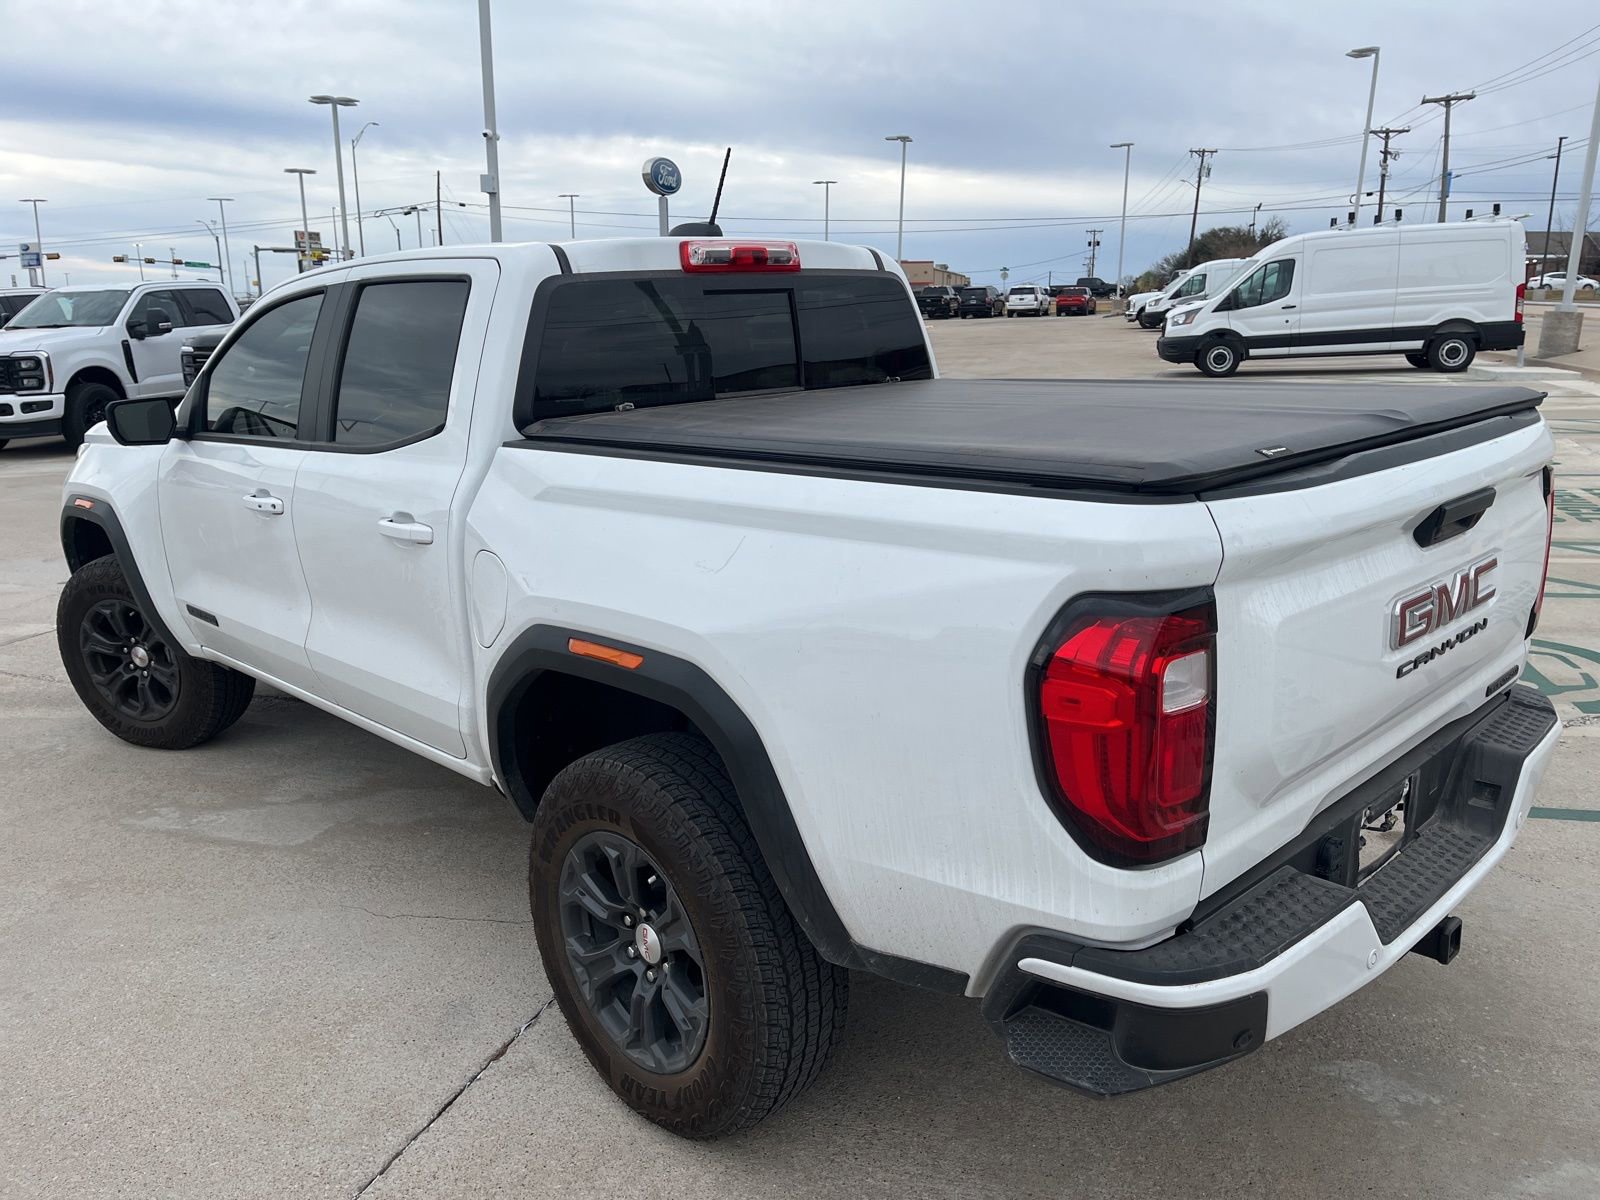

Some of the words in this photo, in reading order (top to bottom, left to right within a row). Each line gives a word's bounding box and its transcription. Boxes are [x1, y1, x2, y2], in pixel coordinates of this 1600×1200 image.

[658, 164, 677, 187] Ford
[1390, 553, 1498, 651] GMC
[1396, 617, 1488, 679] CANYON
[642, 927, 652, 961] GMC
